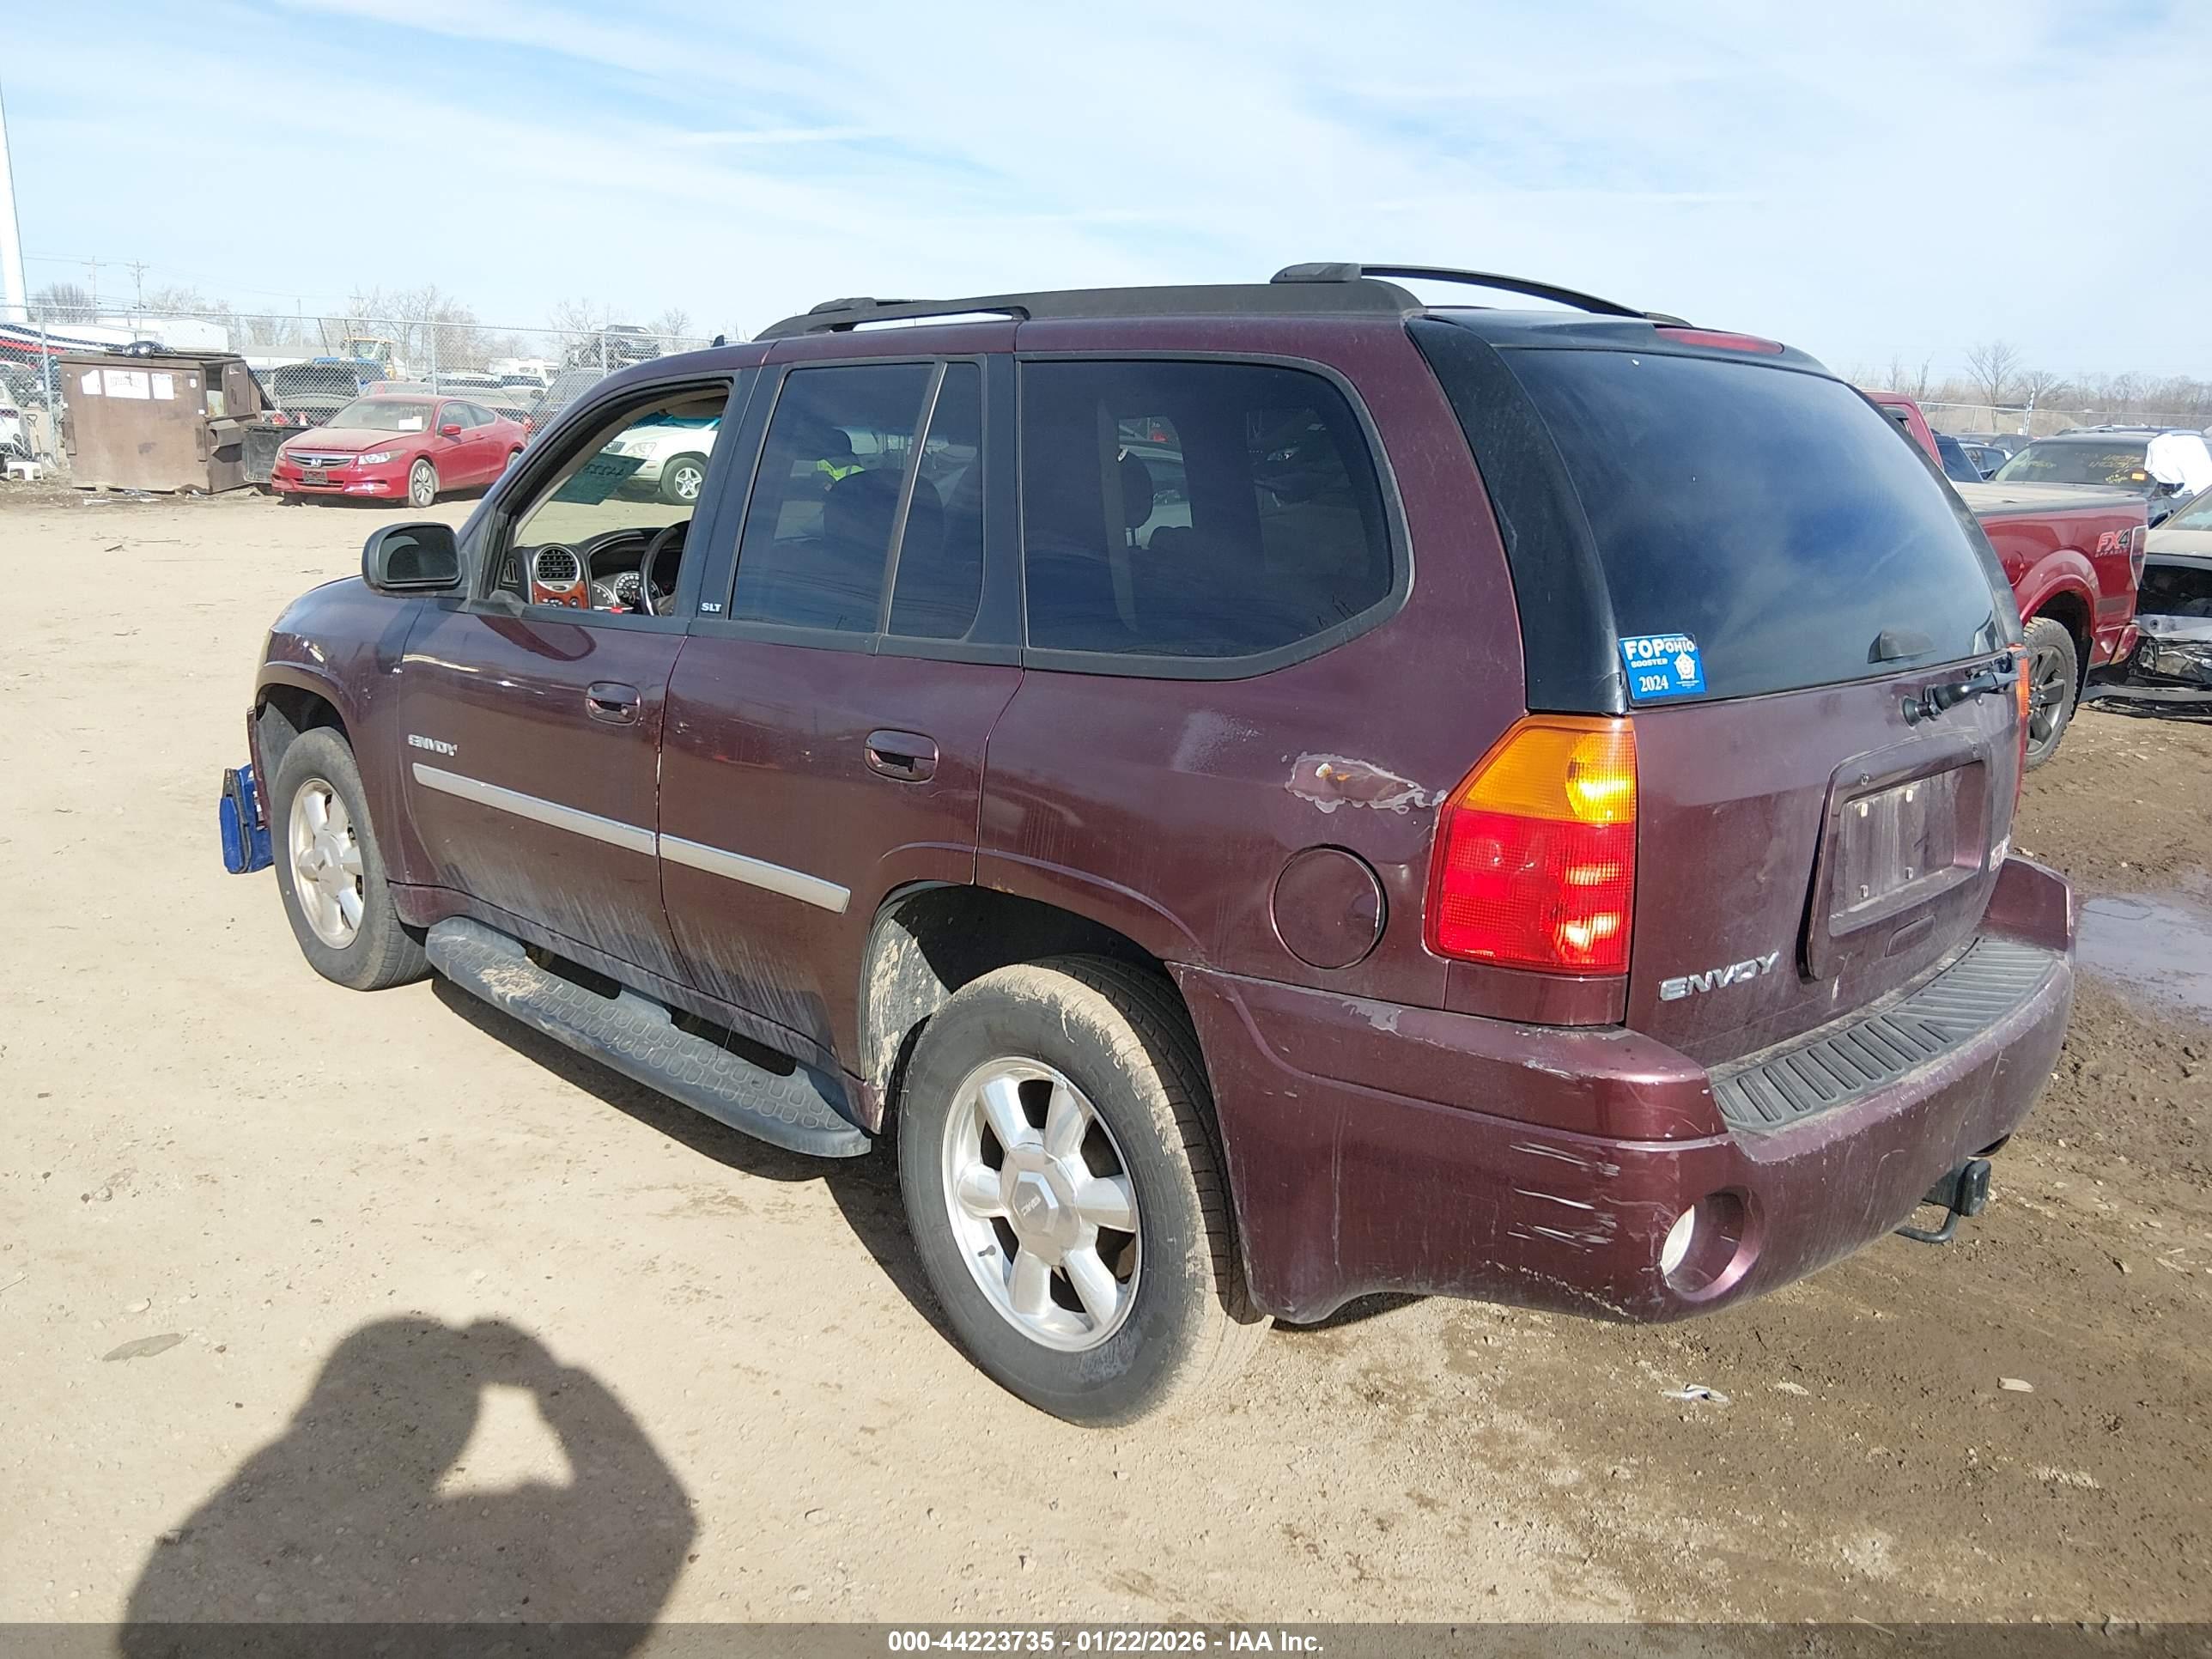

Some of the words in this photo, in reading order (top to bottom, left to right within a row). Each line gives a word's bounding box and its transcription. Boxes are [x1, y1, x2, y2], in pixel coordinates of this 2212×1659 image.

[2096, 528, 2130, 552] FX4
[701, 602, 722, 612] SLT
[1624, 638, 1664, 660] FOP
[1665, 640, 1695, 653] OHIO
[1638, 675, 1669, 692] 2024
[1659, 950, 1780, 1001] ENVOY
